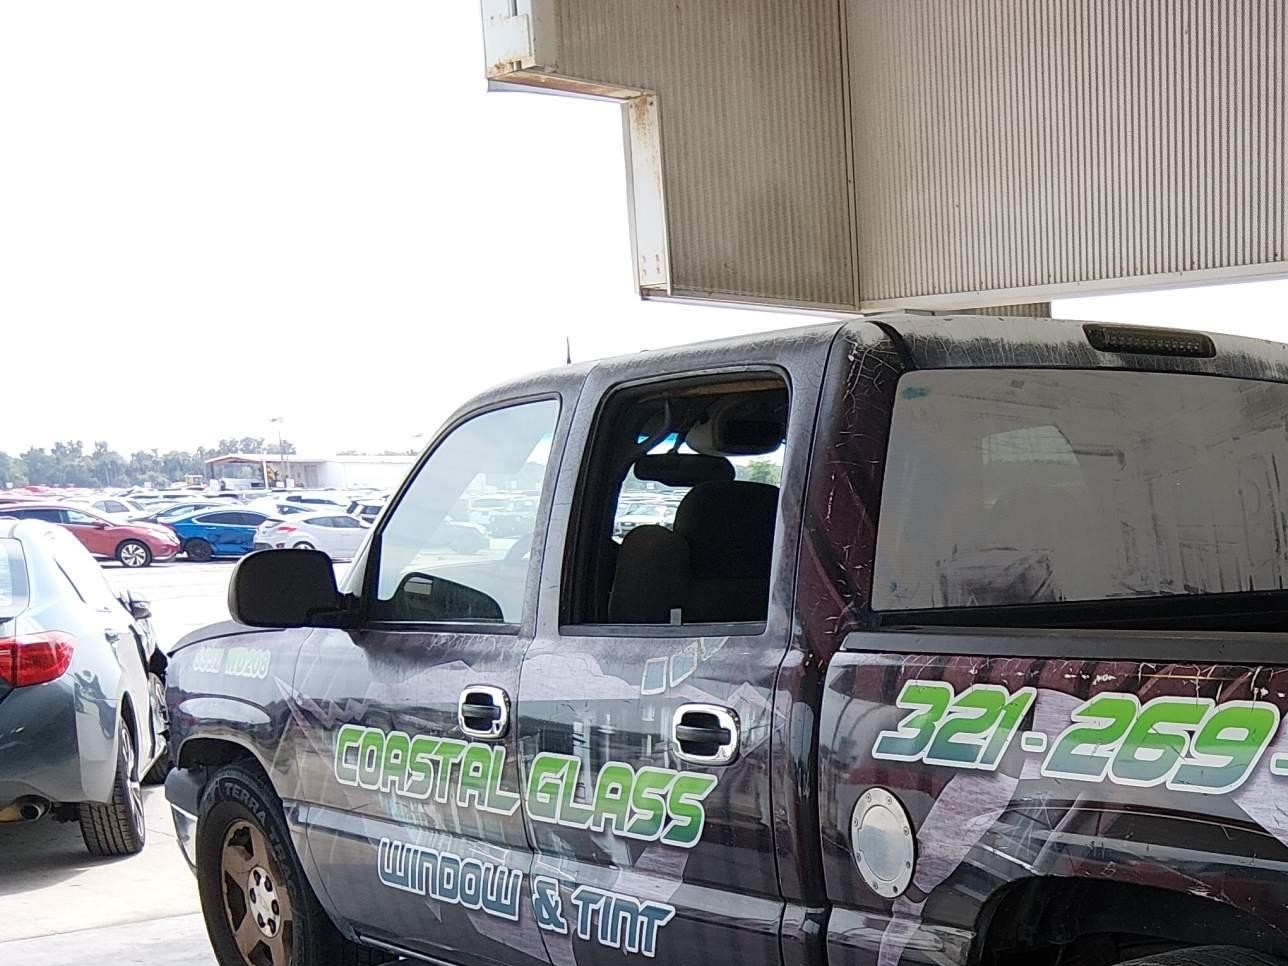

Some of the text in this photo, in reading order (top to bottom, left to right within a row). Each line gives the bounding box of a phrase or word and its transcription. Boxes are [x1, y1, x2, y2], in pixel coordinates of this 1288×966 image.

[224, 782, 267, 827] TERRA
[335, 724, 718, 849] COASTAL GLASS
[376, 837, 677, 958] WINDOW & TINT
